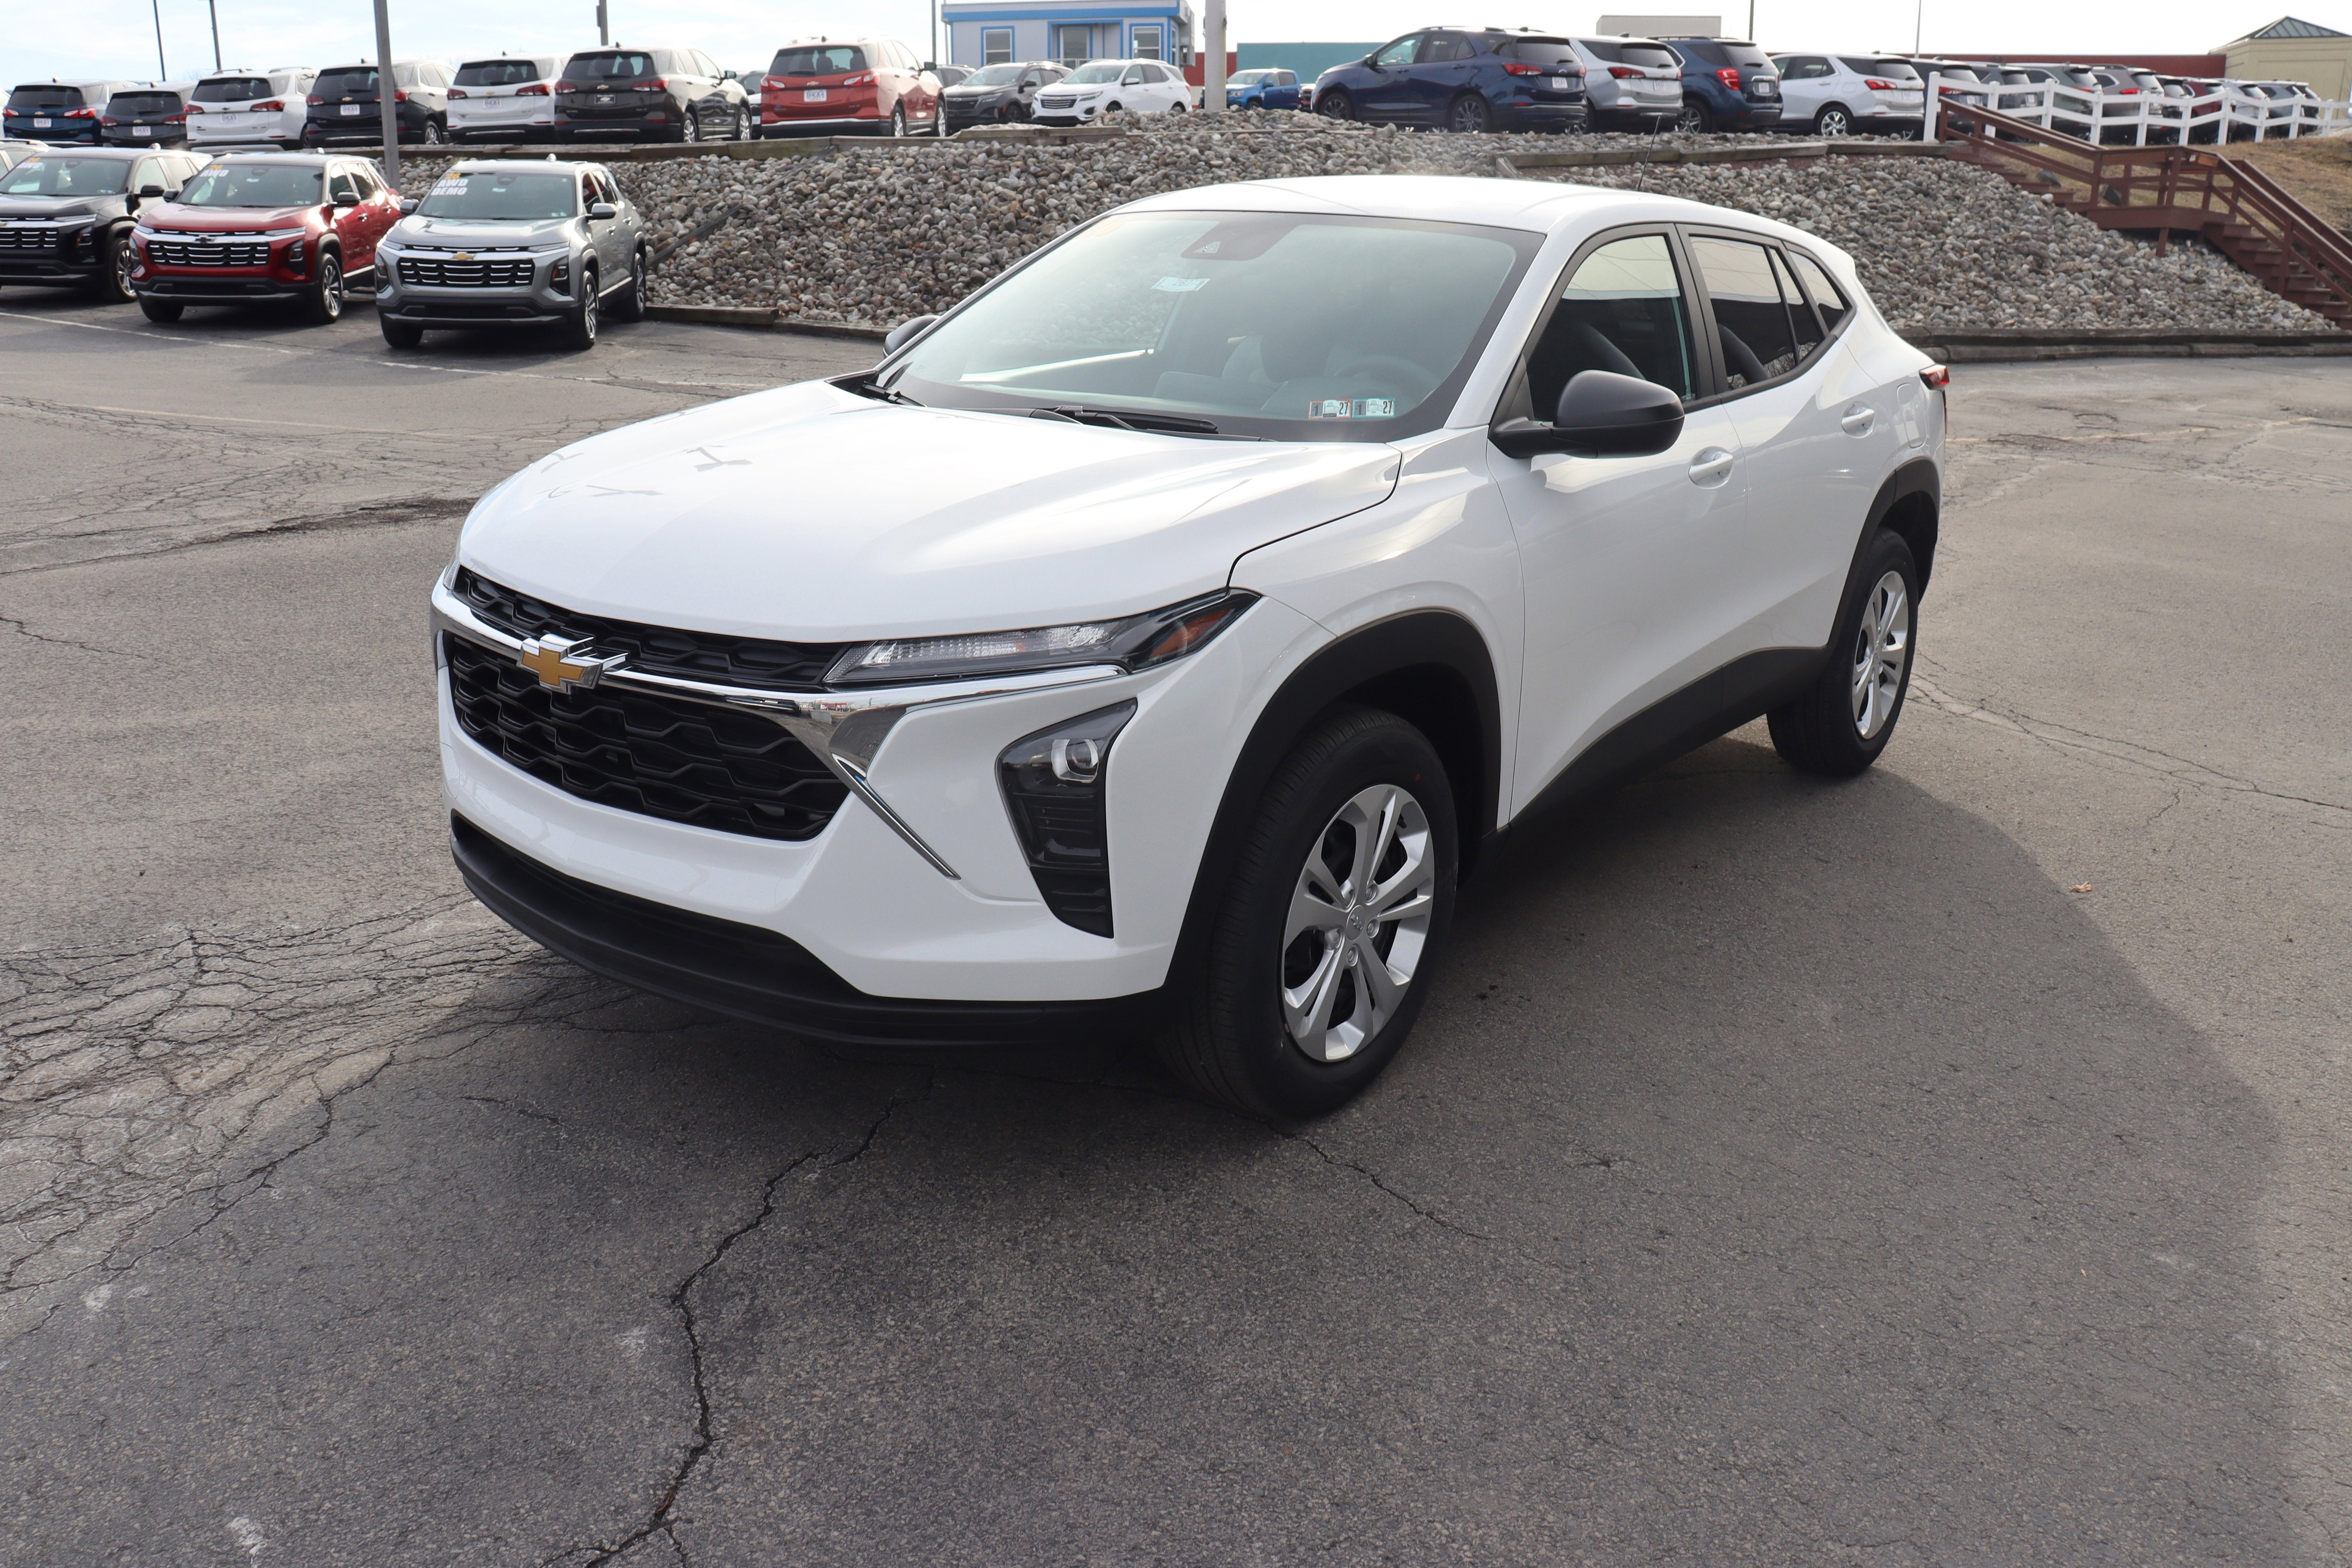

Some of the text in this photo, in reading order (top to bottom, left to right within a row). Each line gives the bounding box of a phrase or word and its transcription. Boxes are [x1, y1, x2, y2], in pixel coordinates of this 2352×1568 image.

[436, 178, 469, 187] AWD
[430, 187, 468, 196] DEMO
[1339, 402, 1349, 415] 27
[1383, 401, 1392, 414] 27
